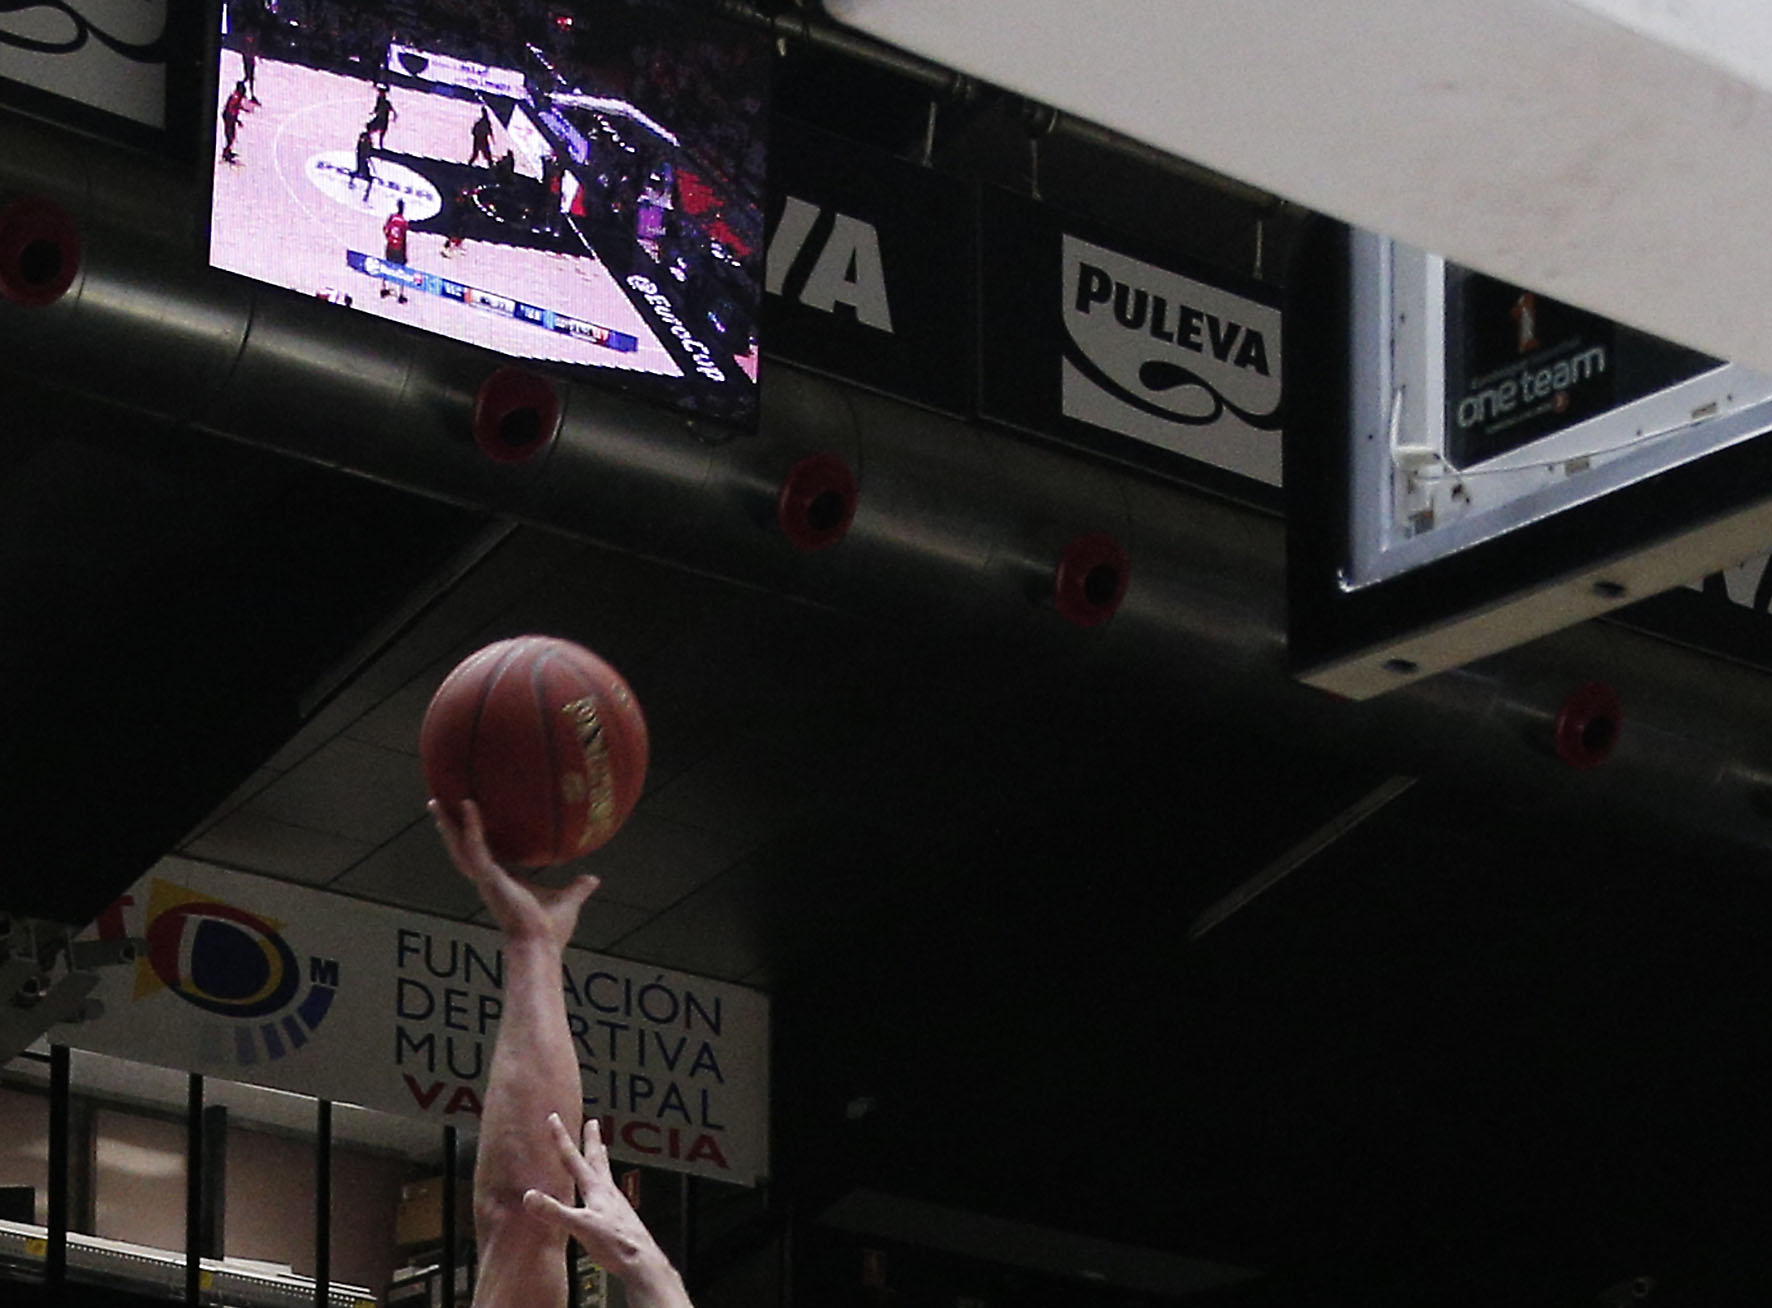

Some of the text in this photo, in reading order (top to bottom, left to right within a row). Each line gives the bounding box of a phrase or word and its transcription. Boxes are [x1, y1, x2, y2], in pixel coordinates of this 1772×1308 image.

[1074, 260, 1272, 377] PULEVA
[1521, 345, 1608, 403] team
[397, 928, 723, 1035] FUNACIÓN
[397, 978, 725, 1085] DEPRTIVA
[397, 1024, 725, 1132] MUCIPAL
